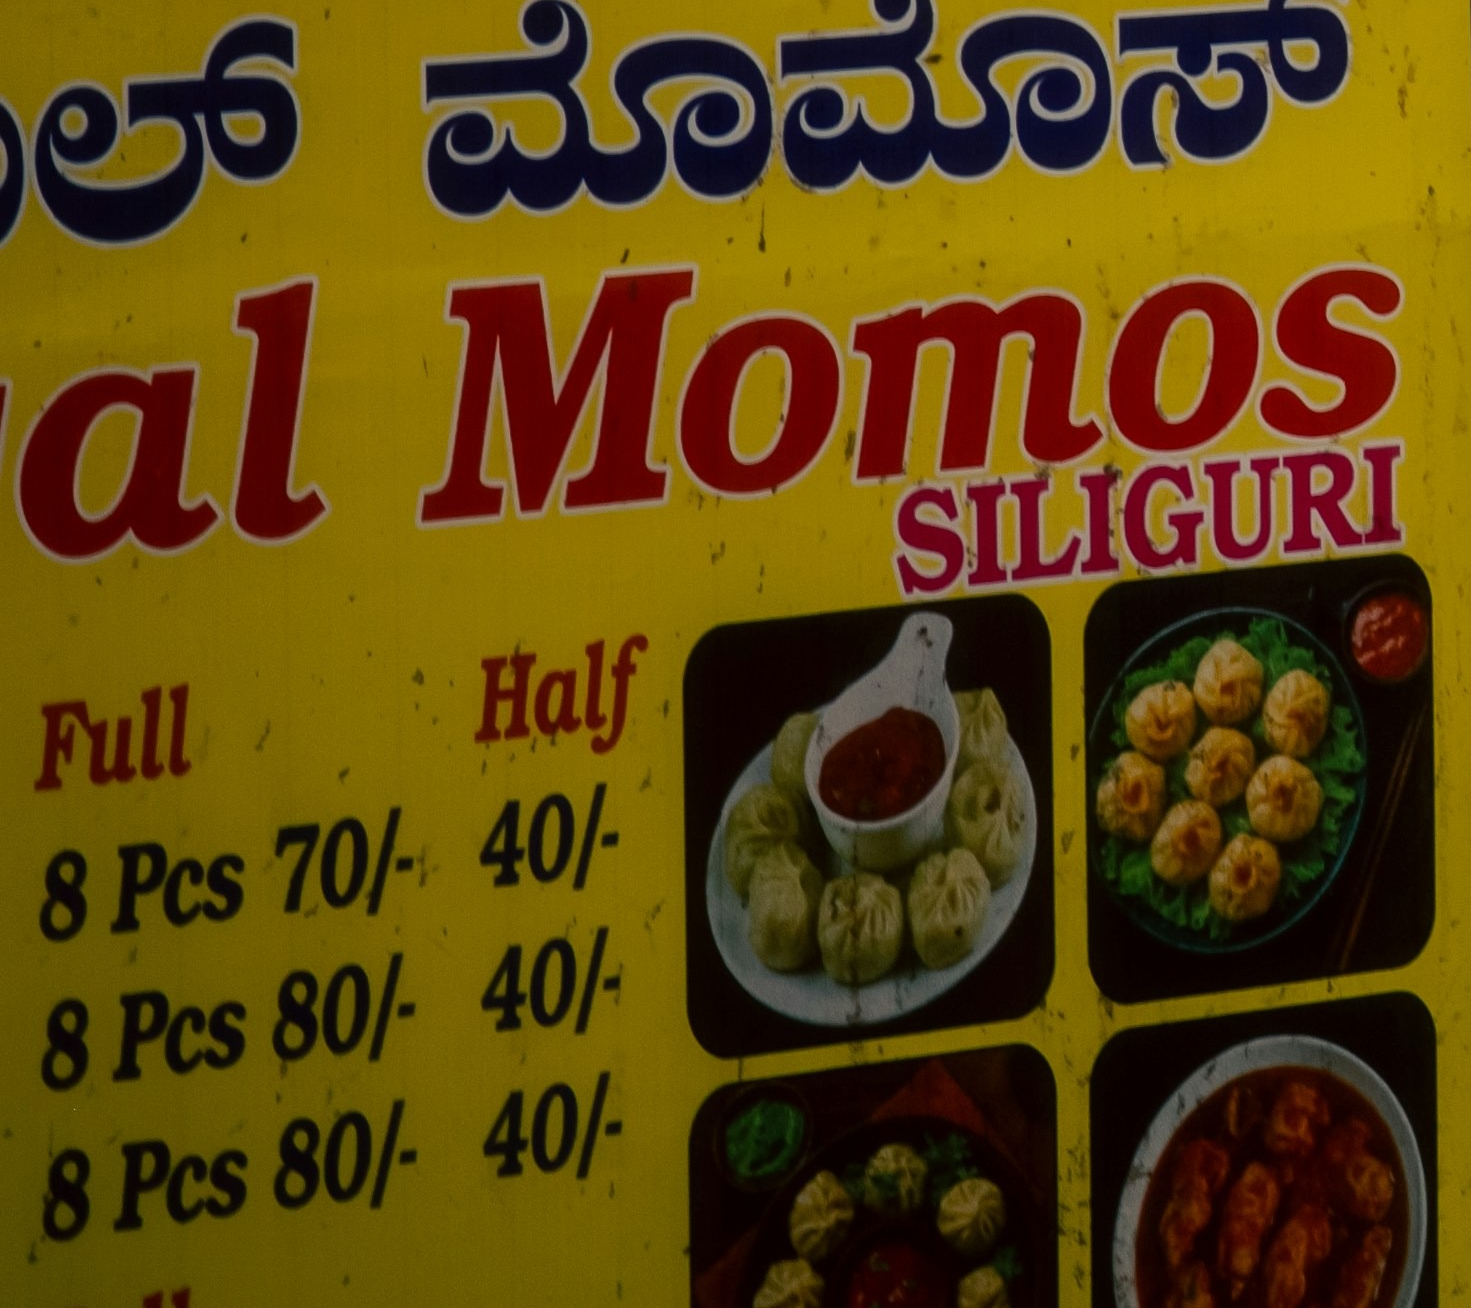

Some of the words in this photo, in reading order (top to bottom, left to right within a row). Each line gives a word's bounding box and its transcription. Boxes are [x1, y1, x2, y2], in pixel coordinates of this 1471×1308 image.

[417, 261, 1405, 531] Momos
[892, 440, 1405, 597] SILIGURI
[34, 683, 193, 792] Full
[473, 633, 649, 756] Half
[39, 849, 88, 943] 8
[110, 842, 246, 934] Pcs
[274, 806, 415, 916] 70/-
[479, 782, 620, 891] 40/-
[40, 998, 90, 1092] 8
[112, 989, 247, 1082] Pcs
[271, 952, 417, 1062] 80/-
[480, 927, 622, 1035] 40/-
[41, 1147, 91, 1242] 8
[113, 1138, 248, 1233] Pcs
[273, 1098, 418, 1210] 80/-
[482, 1071, 624, 1181] 40/-
